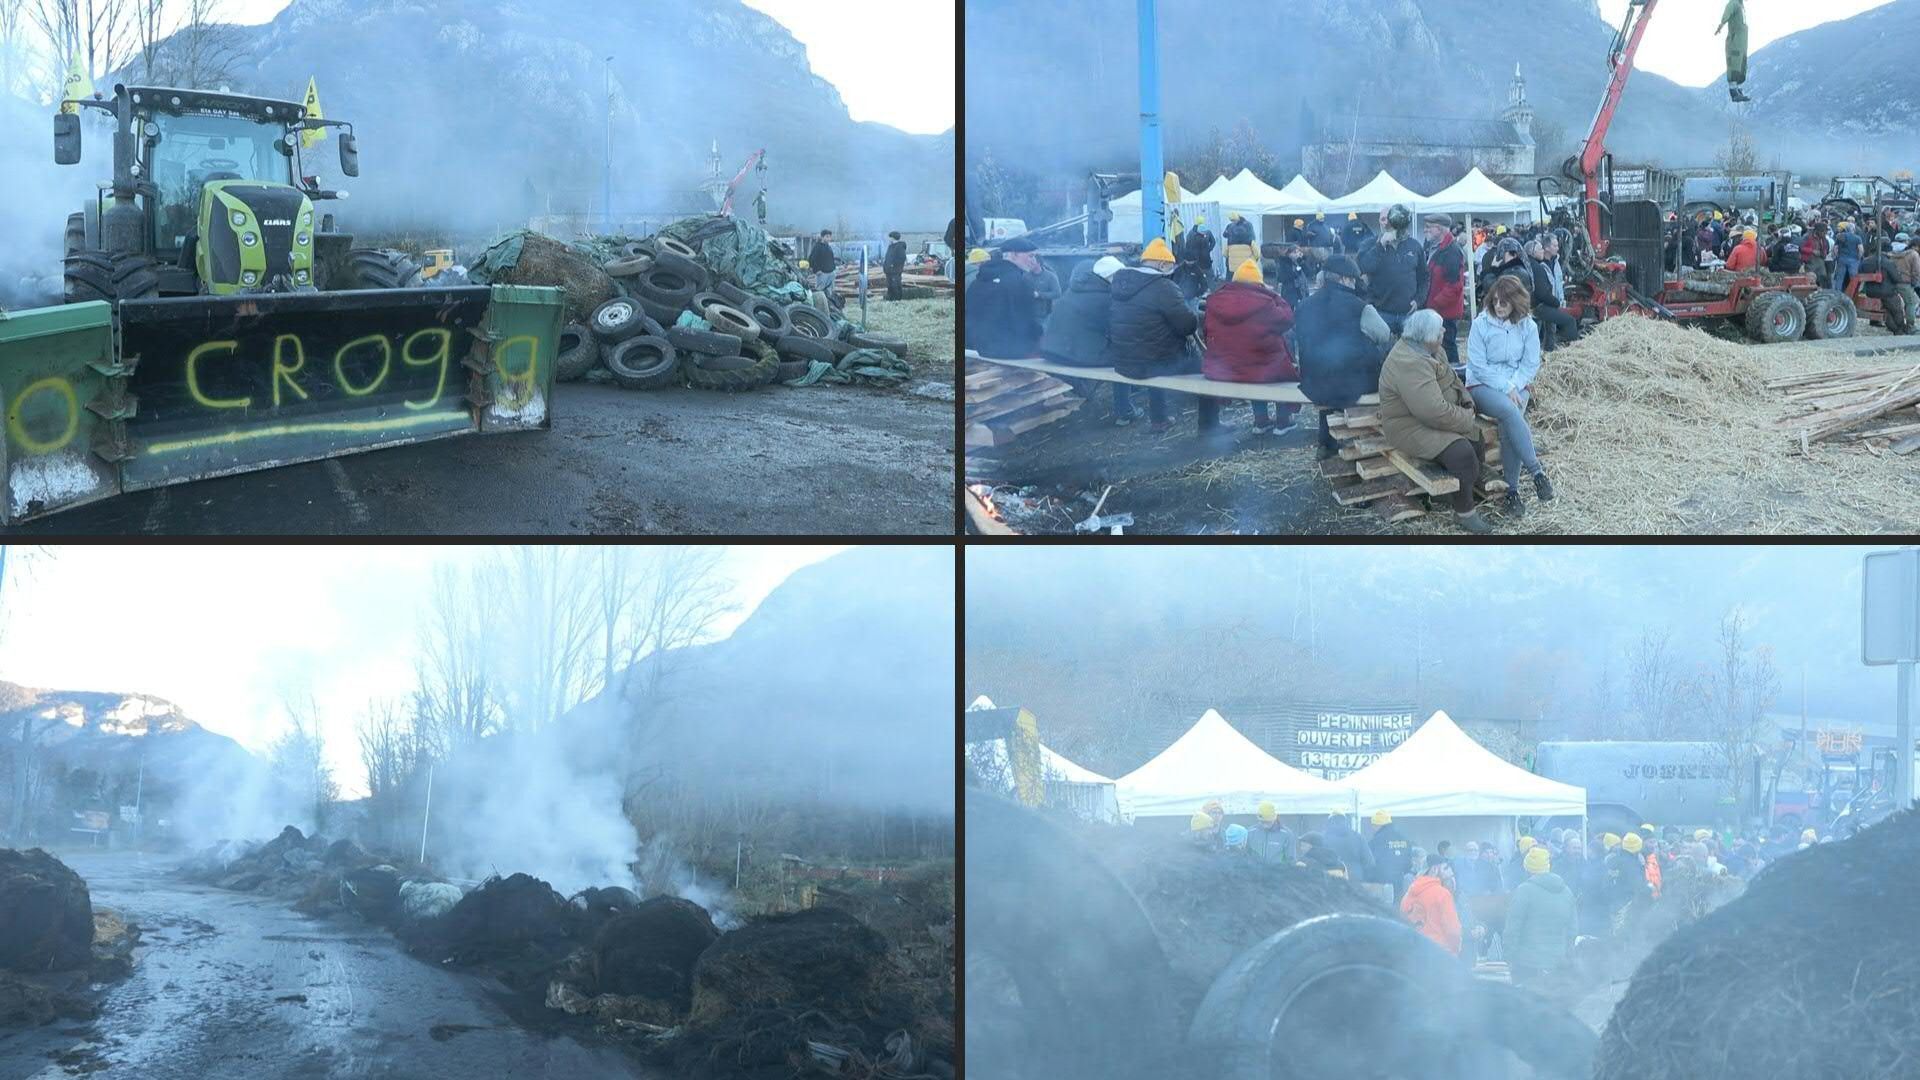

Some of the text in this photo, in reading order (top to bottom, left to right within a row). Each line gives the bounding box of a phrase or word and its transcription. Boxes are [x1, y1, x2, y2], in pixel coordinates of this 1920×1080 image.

[1319, 713, 1410, 730] PEPINIERE
[1299, 730, 1407, 747] OUVERTE ICI
